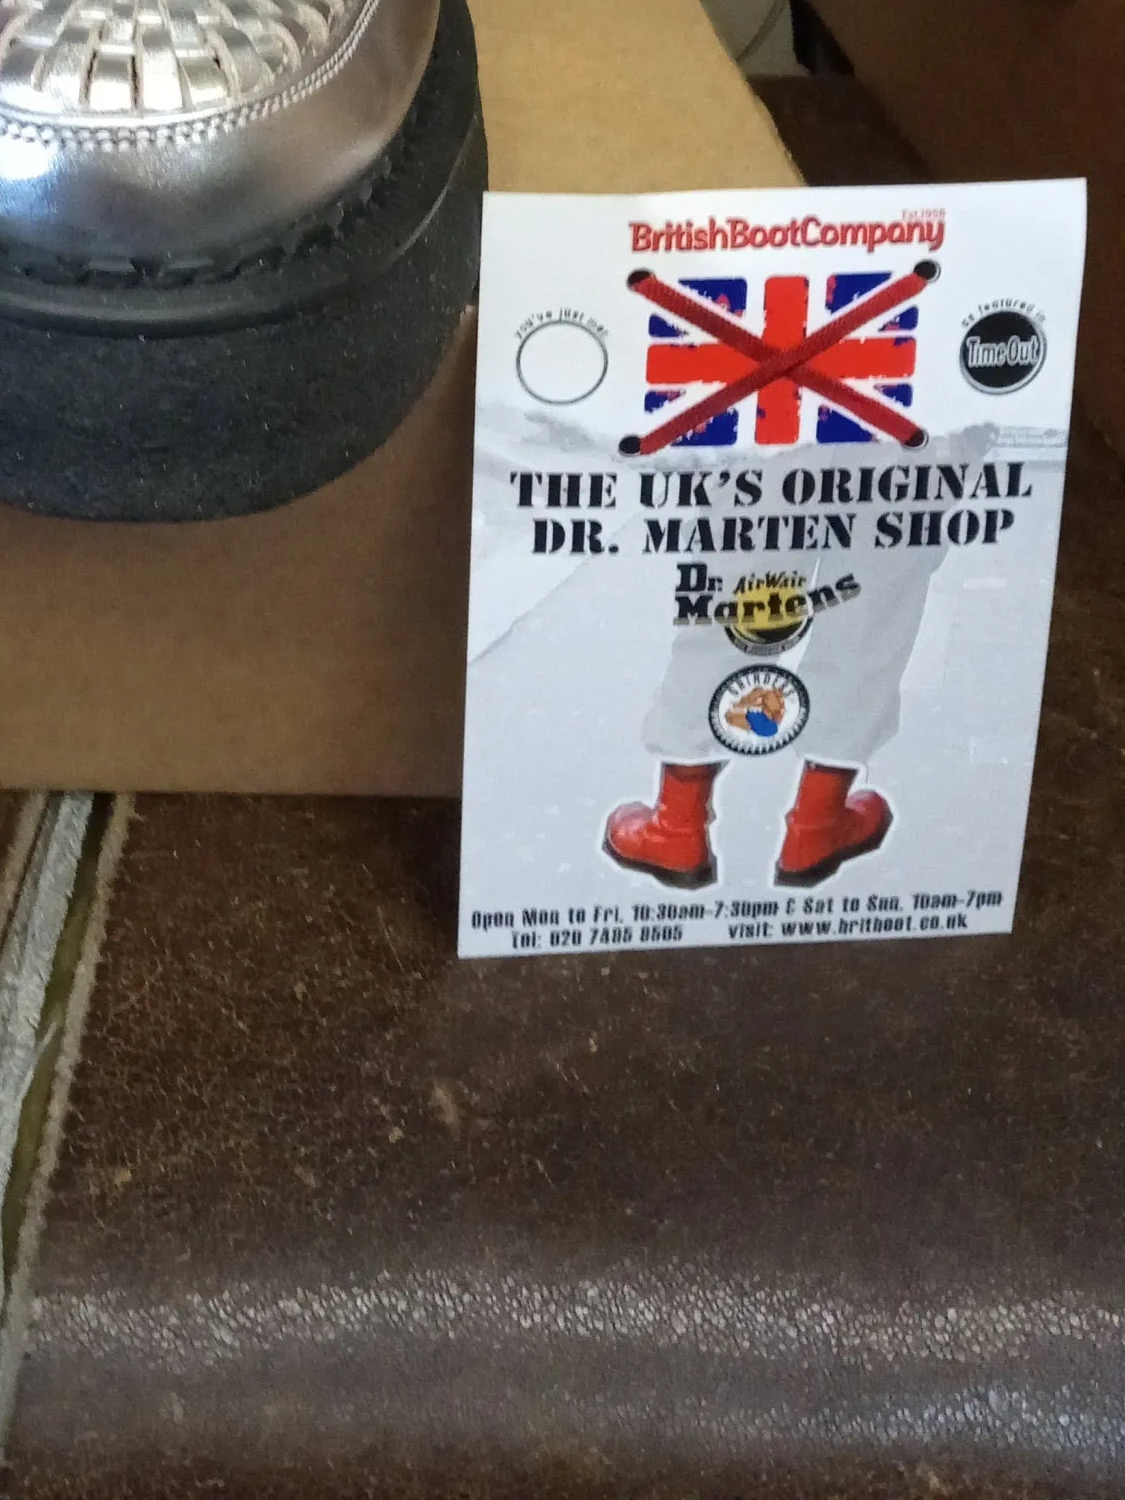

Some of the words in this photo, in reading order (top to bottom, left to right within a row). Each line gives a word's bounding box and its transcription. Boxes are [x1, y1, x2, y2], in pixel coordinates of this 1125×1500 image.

[629, 212, 945, 254] BritishBootCompany
[510, 471, 617, 509] THE
[639, 469, 764, 508] UK'S
[781, 462, 1033, 504] ORIGINAL
[531, 518, 621, 555] DR.
[642, 513, 858, 554] MARTEN
[874, 508, 1016, 549] SHOP
[674, 573, 861, 623] Martens
[471, 910, 515, 931] Open
[521, 907, 560, 928] Mon
[568, 906, 586, 925] to
[802, 896, 834, 915] Sat
[842, 895, 860, 913] to
[911, 890, 1003, 911] 10am-7pm
[549, 929, 583, 947] 020
